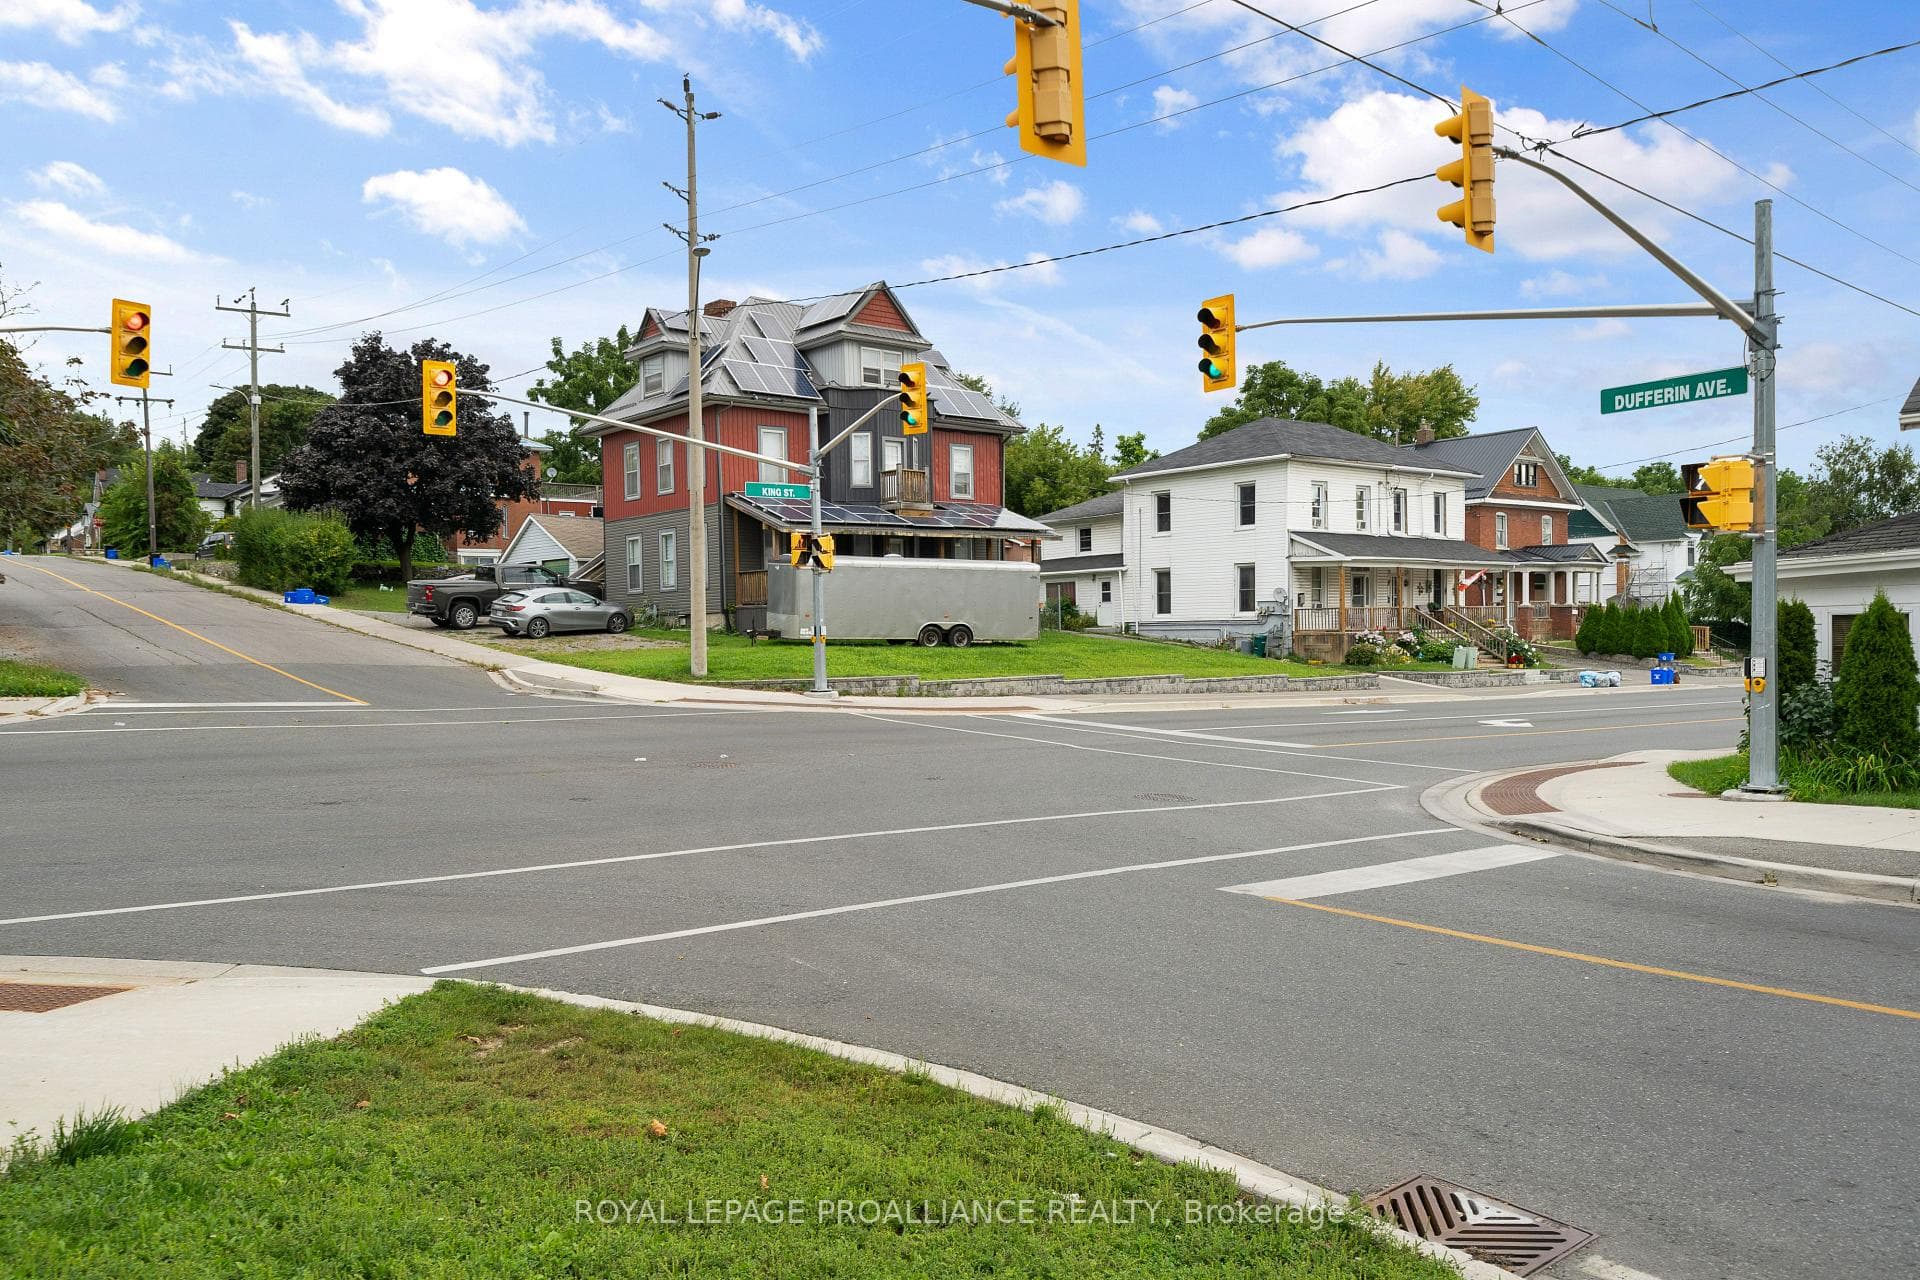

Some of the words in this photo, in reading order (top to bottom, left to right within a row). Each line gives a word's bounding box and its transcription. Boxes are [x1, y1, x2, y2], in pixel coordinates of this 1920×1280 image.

[1614, 384, 1690, 410] DUFFERIN
[1695, 378, 1732, 399] AVE.
[762, 487, 782, 496] KING
[783, 488, 795, 497] ST.
